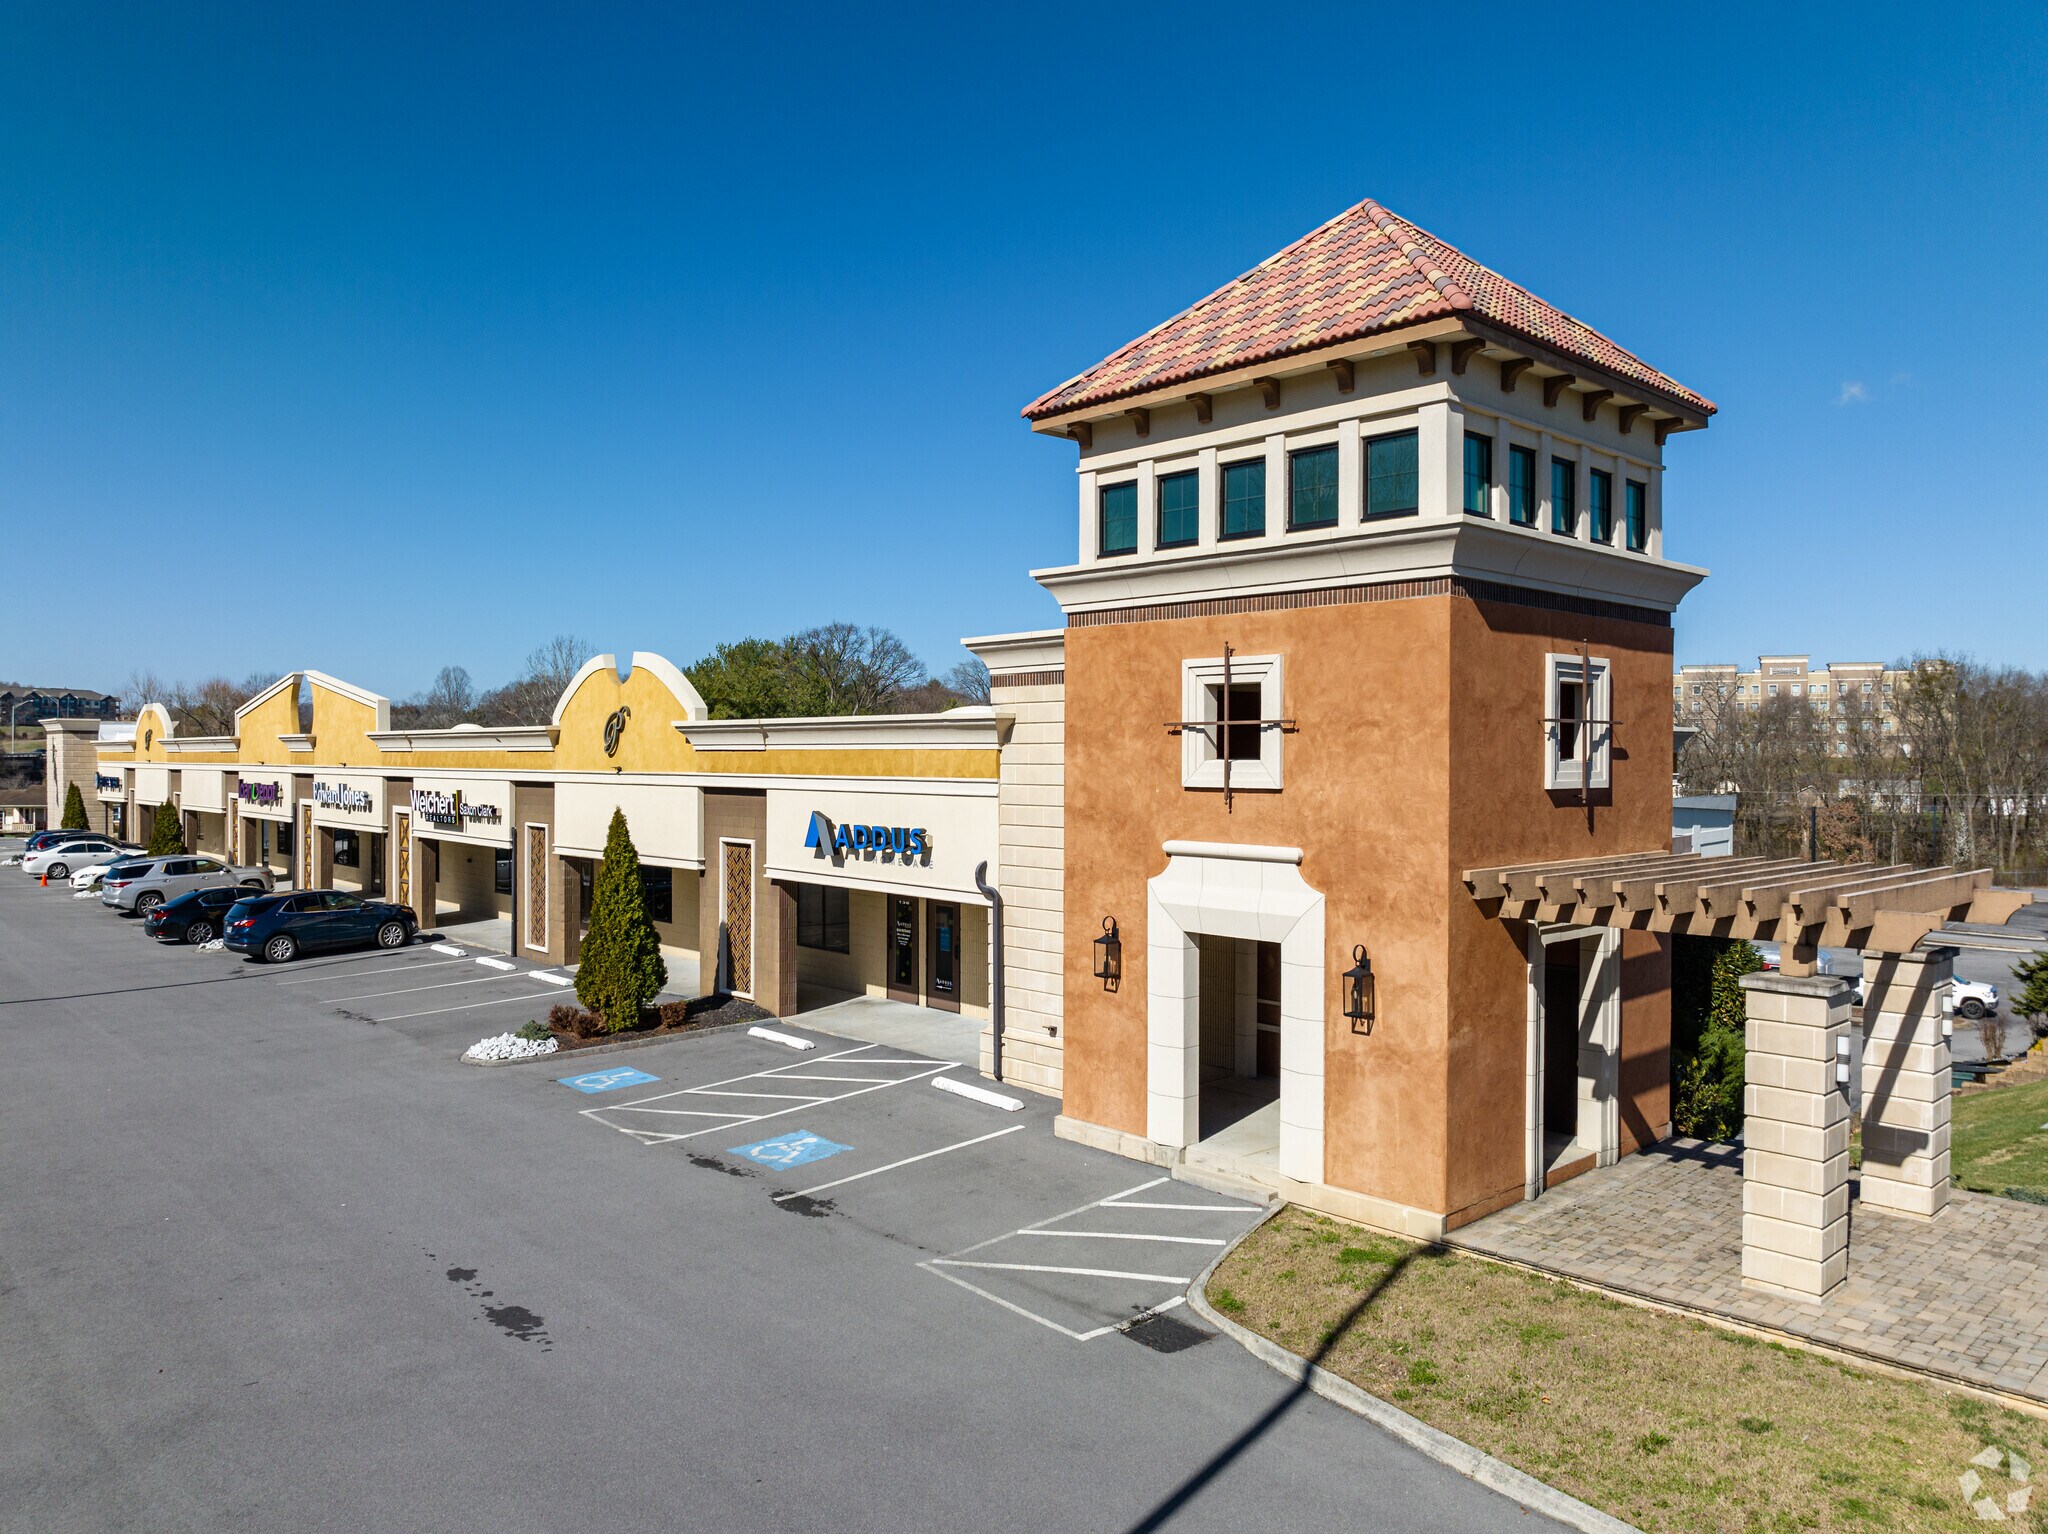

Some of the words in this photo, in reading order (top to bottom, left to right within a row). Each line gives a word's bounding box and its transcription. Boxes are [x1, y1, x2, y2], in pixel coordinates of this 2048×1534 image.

[340, 784, 365, 807] Jones
[477, 804, 493, 817] Clark
[425, 814, 456, 824] REALTORS
[835, 823, 923, 855] ADDUS
[872, 857, 934, 870] HOMECARE
